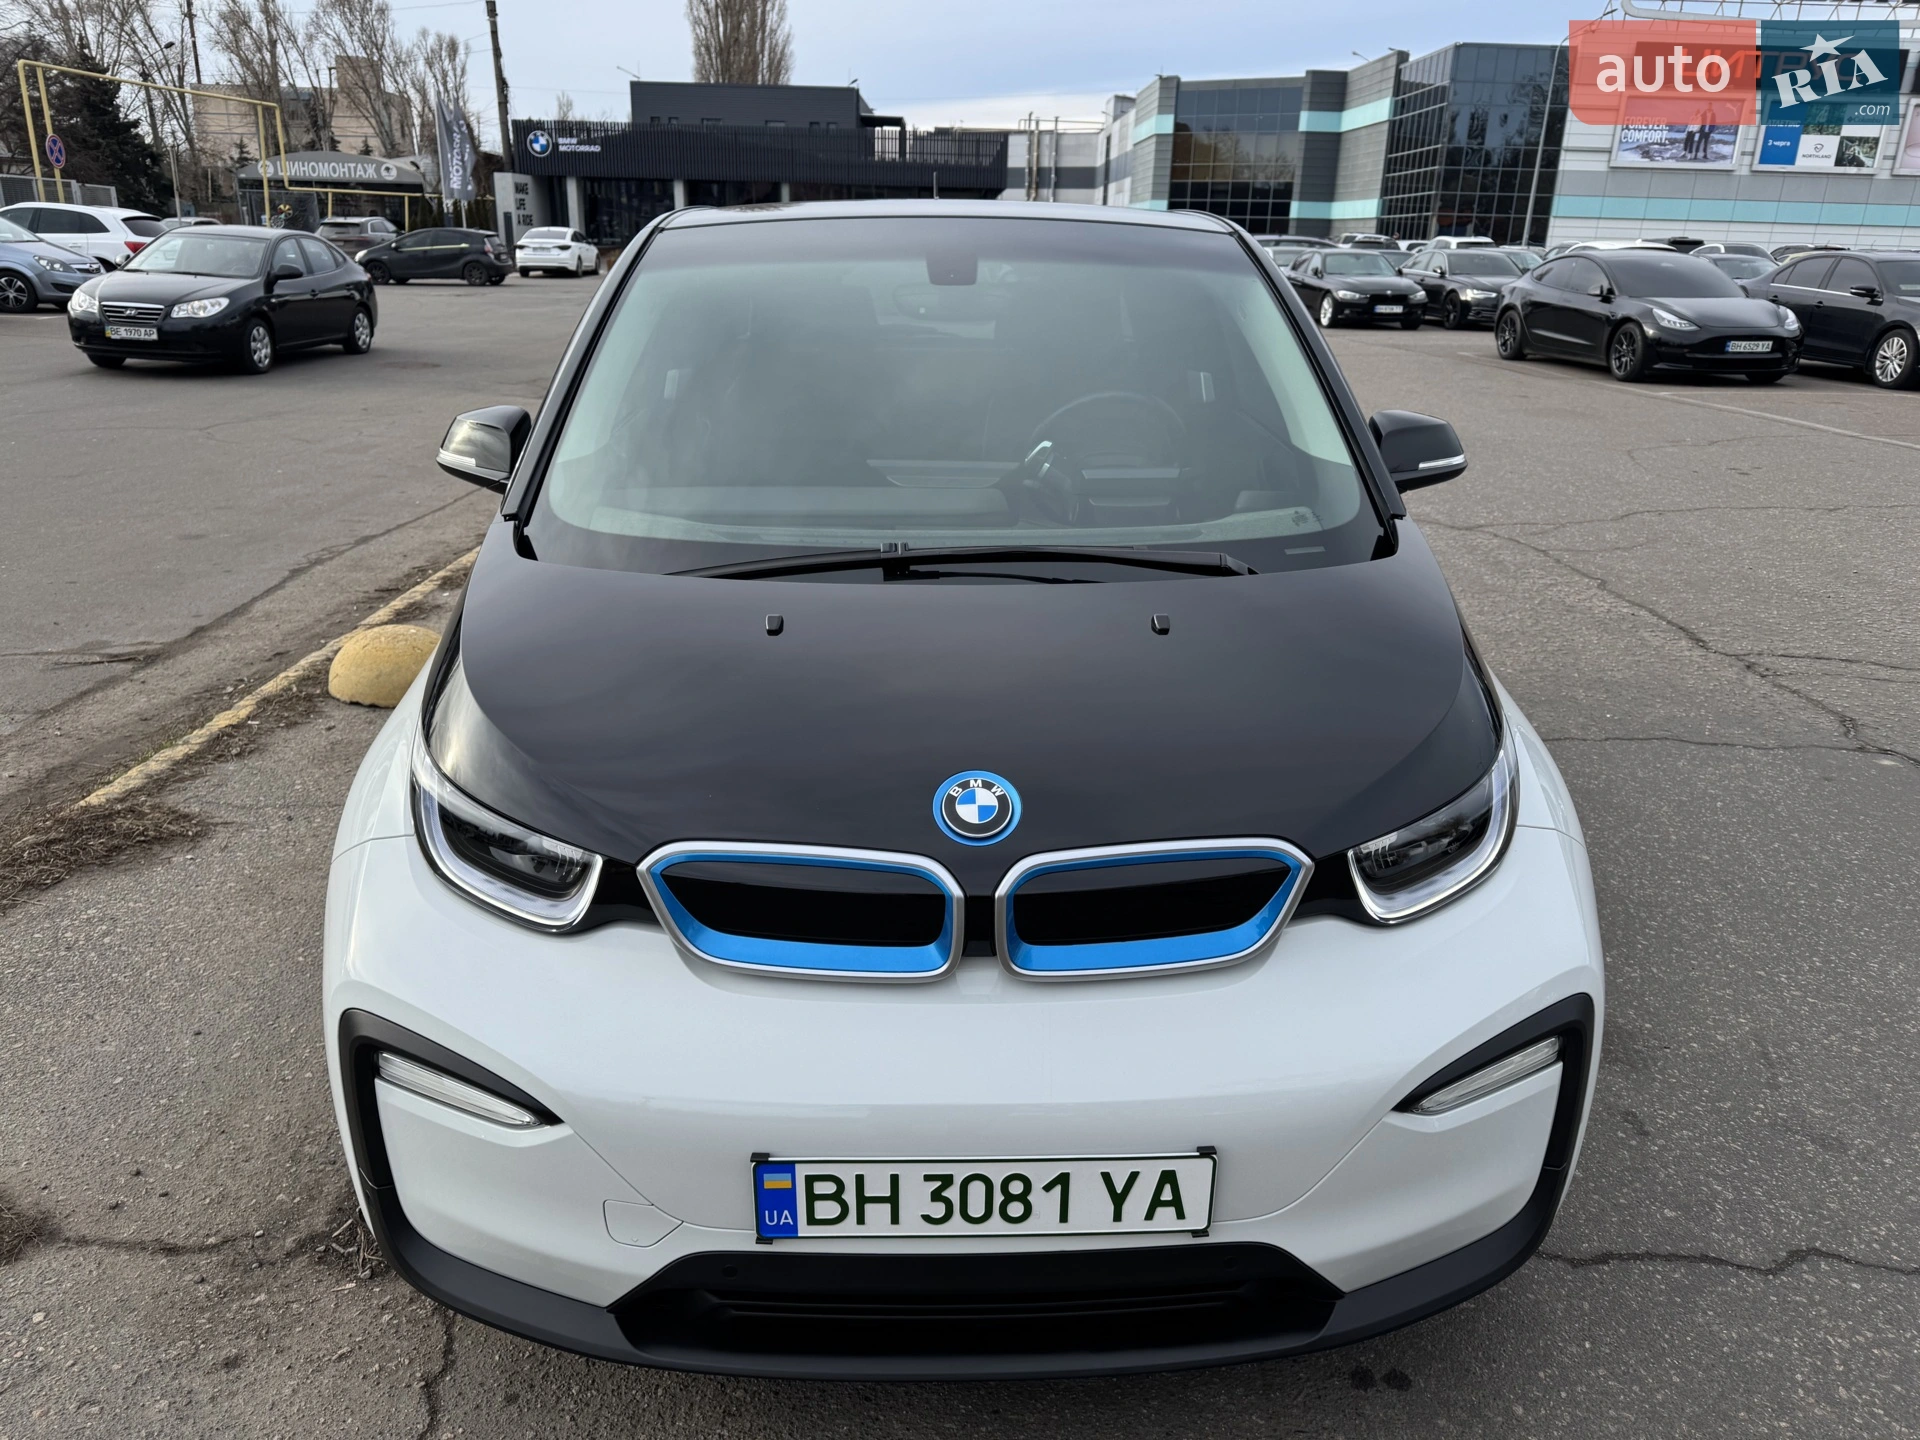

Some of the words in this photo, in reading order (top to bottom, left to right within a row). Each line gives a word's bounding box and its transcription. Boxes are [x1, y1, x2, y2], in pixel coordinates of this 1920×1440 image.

[1621, 130, 1669, 143] COMFORT.
[276, 160, 377, 179] ШИНОМОНТАЖ
[124, 328, 142, 337] 1970
[949, 779, 1005, 798] BMW
[804, 1173, 899, 1226] BH
[920, 1171, 1071, 1226] 3081
[1100, 1169, 1186, 1223] YA
[764, 1209, 794, 1226] UA
